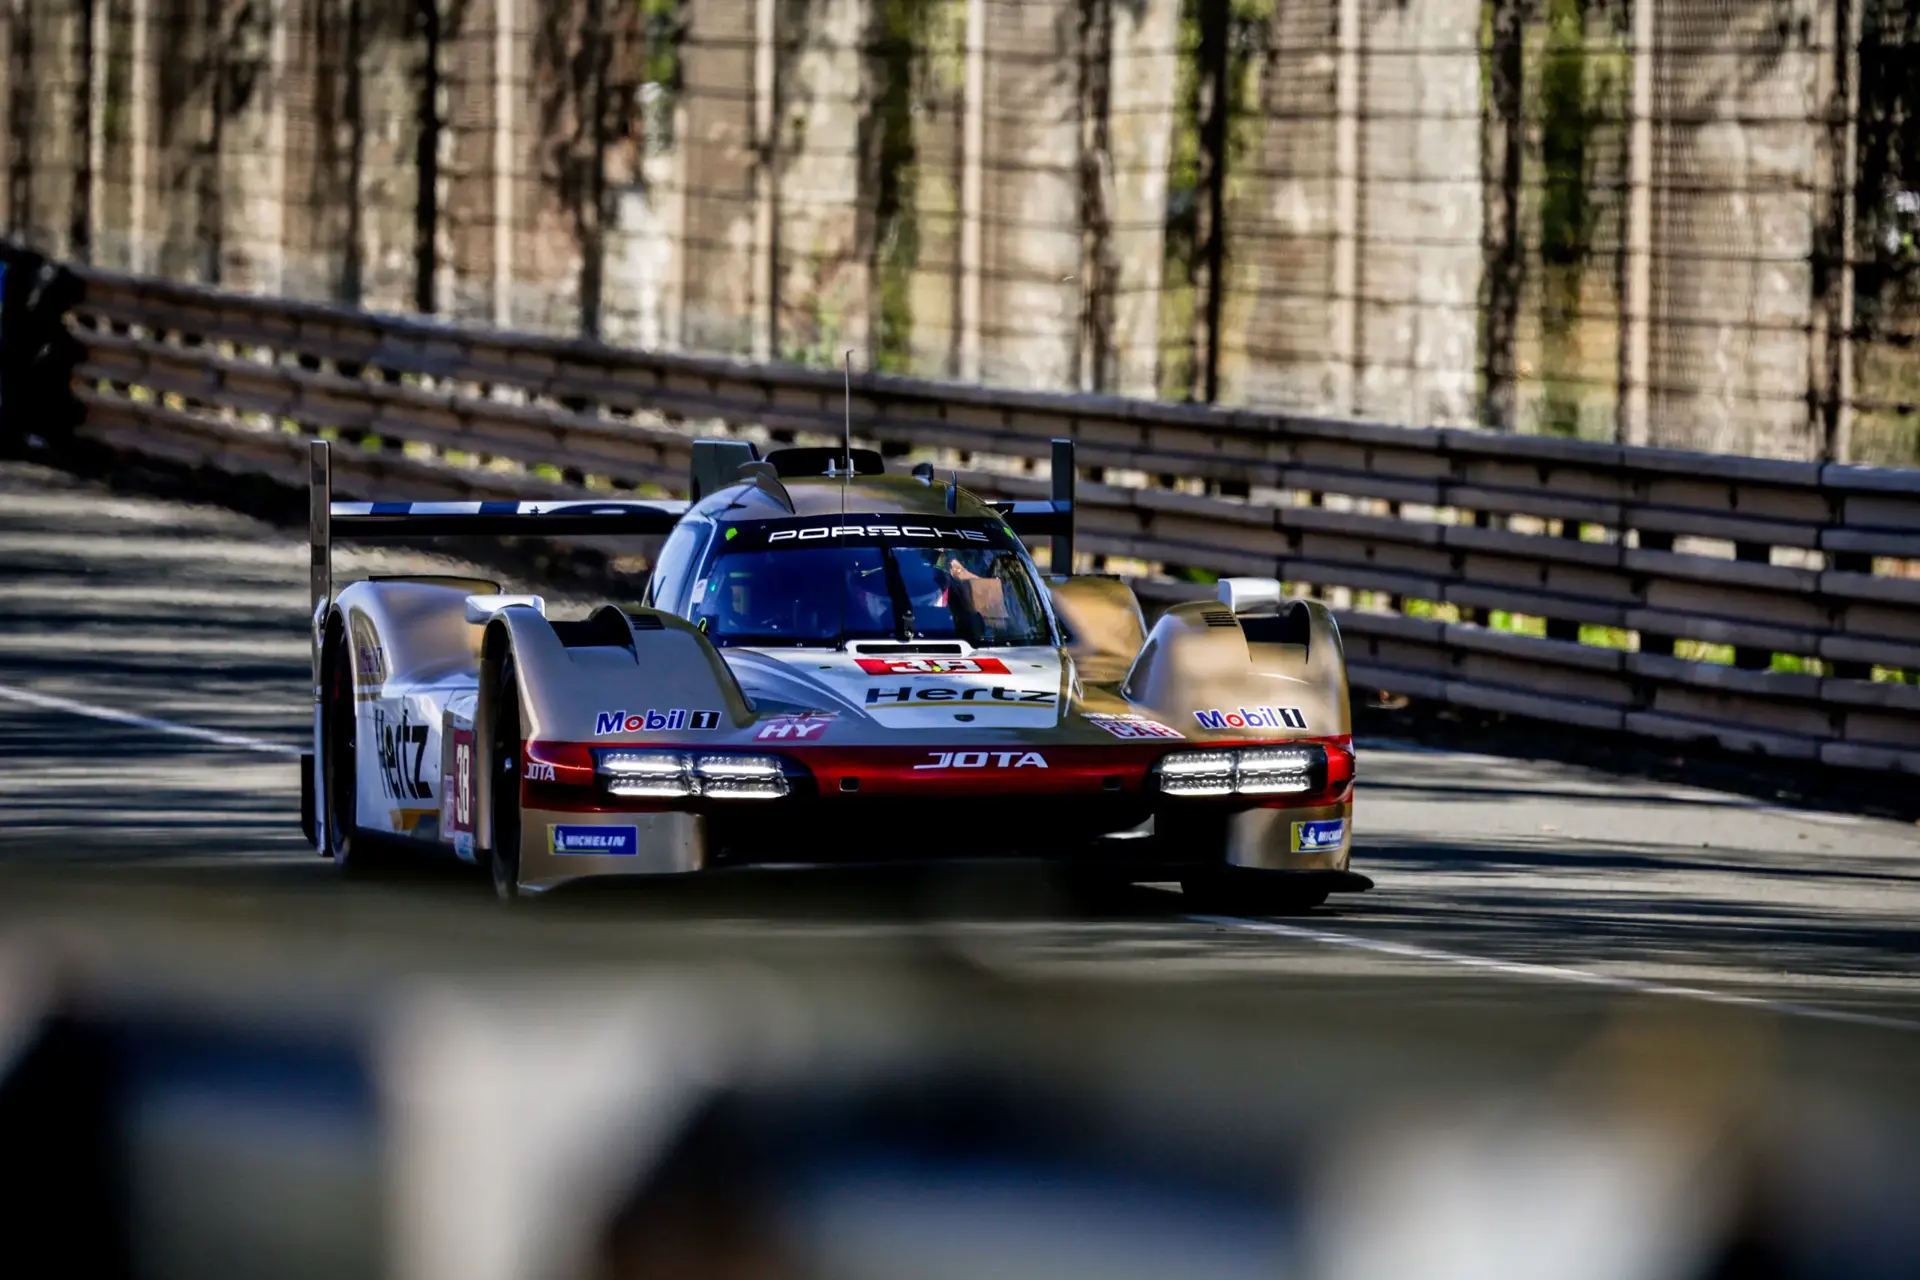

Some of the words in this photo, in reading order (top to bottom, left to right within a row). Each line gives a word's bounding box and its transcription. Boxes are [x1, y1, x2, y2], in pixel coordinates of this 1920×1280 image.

[768, 526, 990, 543] PORSCHE
[883, 658, 984, 673] 38
[865, 686, 1058, 704] Hertz
[596, 710, 685, 734] Mobil
[1195, 708, 1279, 730] Mobil
[374, 707, 433, 800] Hertz
[913, 751, 1048, 769] JOTA
[524, 762, 556, 781] JOTA
[456, 744, 470, 825] 38
[565, 835, 626, 847] MICHELIN
